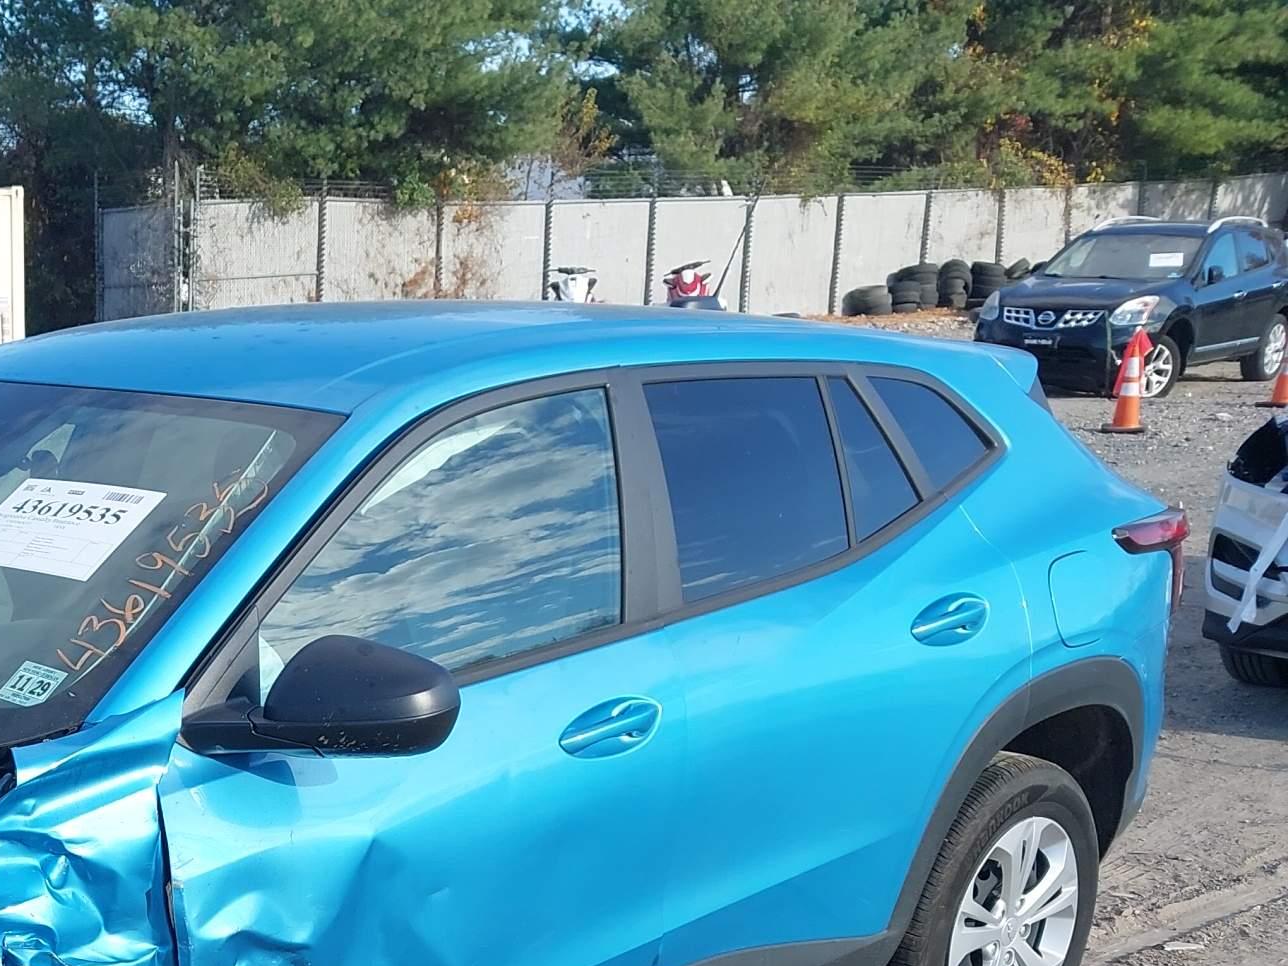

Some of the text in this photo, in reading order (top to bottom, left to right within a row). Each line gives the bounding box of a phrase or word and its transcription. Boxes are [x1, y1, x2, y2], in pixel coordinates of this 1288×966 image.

[12, 498, 128, 525] 43619535
[56, 468, 269, 671] 43619535
[9, 674, 52, 697] 11 29
